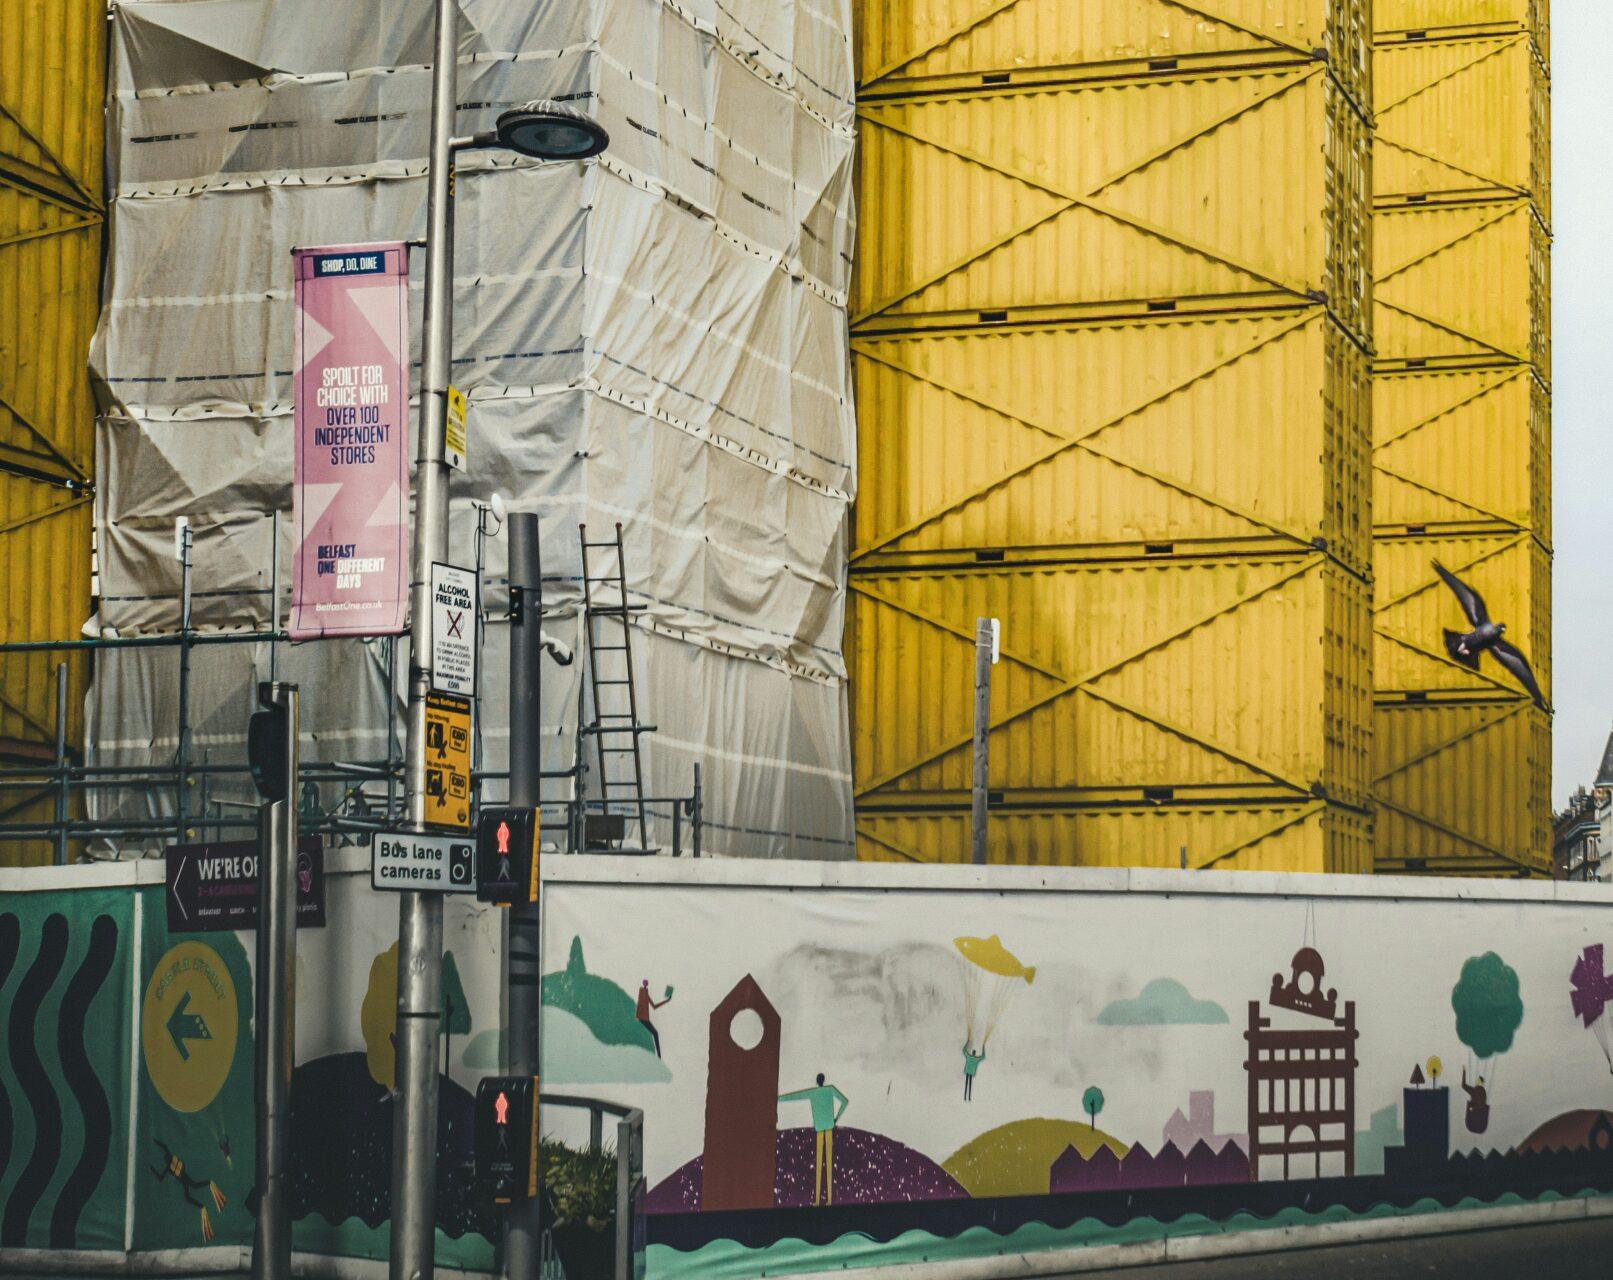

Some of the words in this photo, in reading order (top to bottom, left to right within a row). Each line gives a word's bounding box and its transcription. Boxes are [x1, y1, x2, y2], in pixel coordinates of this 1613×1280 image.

[360, 256, 378, 270] DINE
[322, 366, 360, 387] SPOILT
[362, 365, 382, 384] FOR
[317, 386, 357, 407] CHOICE
[359, 384, 388, 405] WITH
[326, 407, 356, 426] OVER
[360, 406, 379, 424] 100
[314, 424, 390, 446] INDEPENDENT
[331, 446, 375, 465] STORES
[318, 544, 356, 559] BELFAST
[318, 560, 336, 576] ONE
[337, 558, 385, 574] DIFFERENT
[336, 574, 362, 589] DAYS
[438, 582, 470, 598] ALCOHOL
[316, 600, 382, 612] BelfastOne.co.uk
[436, 594, 452, 606] FREE
[454, 598, 472, 610] AREA
[380, 842, 408, 858] Bus
[412, 844, 442, 860] lane
[198, 857, 240, 880] WE'RE
[380, 866, 441, 880] cameras
